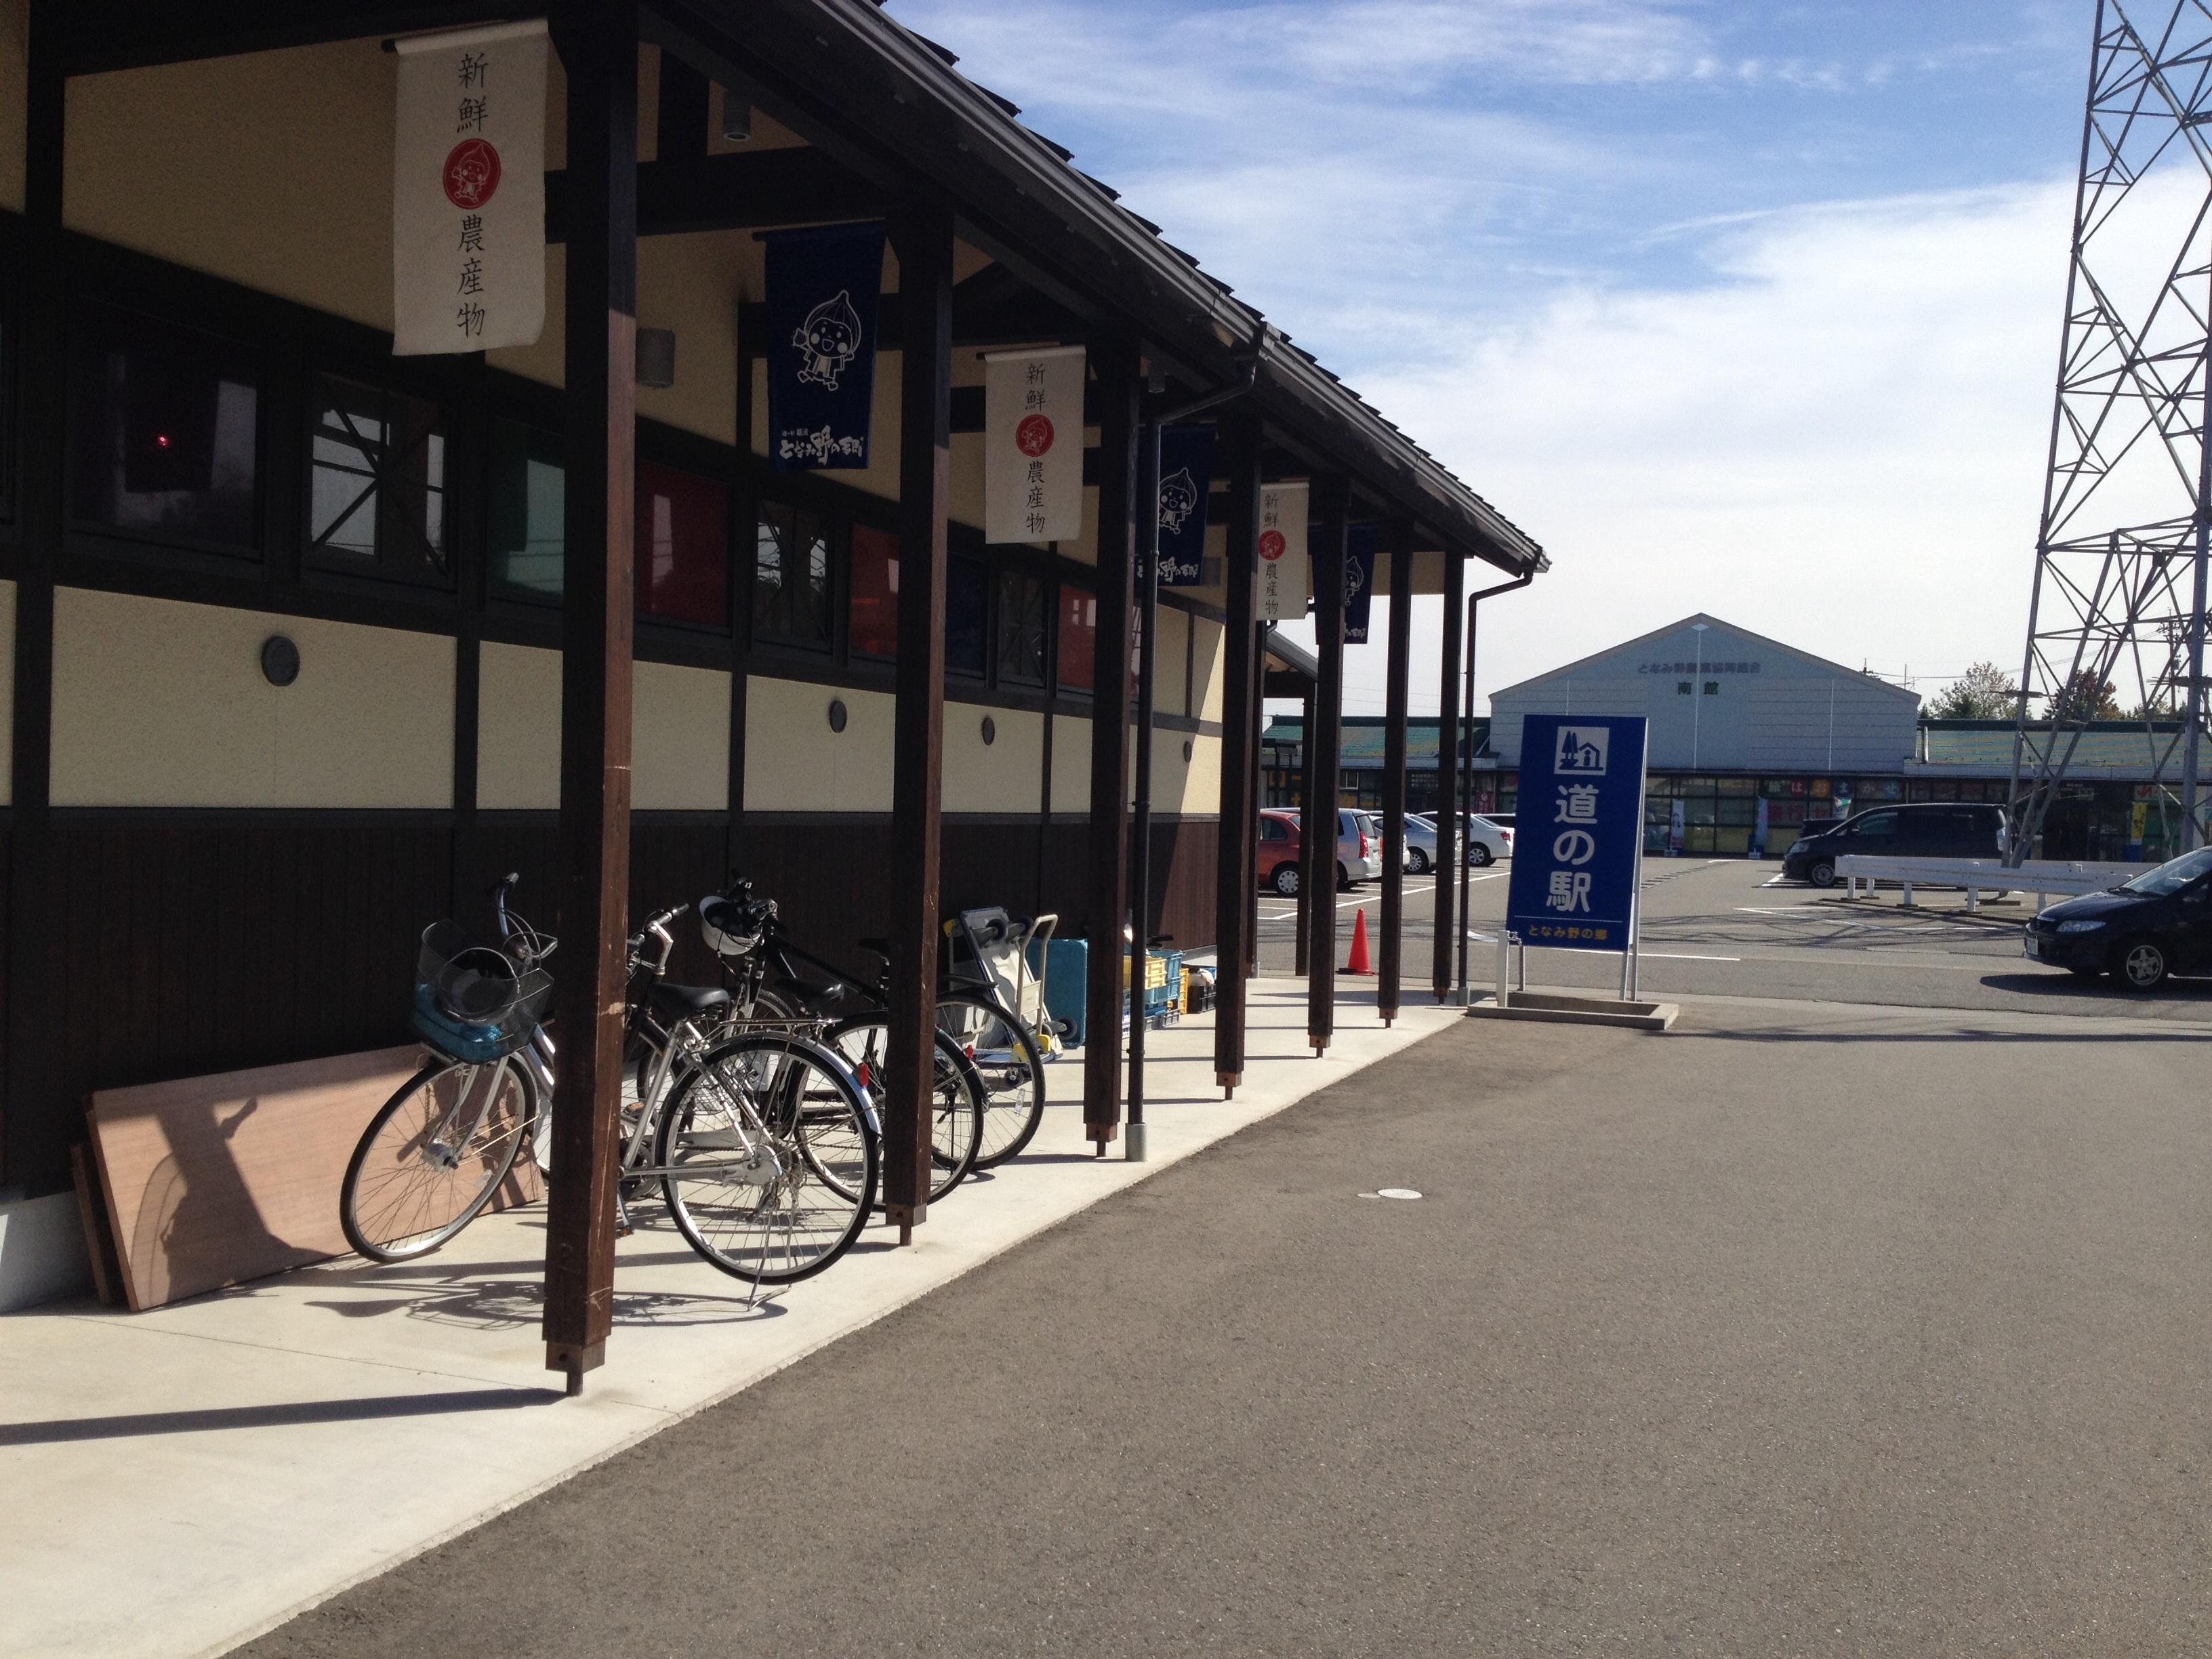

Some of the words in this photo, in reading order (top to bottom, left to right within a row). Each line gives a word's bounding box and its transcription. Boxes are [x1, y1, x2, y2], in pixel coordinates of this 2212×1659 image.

[457, 53, 488, 134] 新鮮
[457, 214, 485, 338] 農産物
[1025, 363, 1046, 411] 新鮮
[1027, 460, 1046, 534] 農産物
[1263, 493, 1279, 528] 新鮮
[1265, 561, 1279, 615] 農産物
[1546, 784, 1599, 912] 道の駅
[1529, 924, 1607, 941] となみ野の郷
